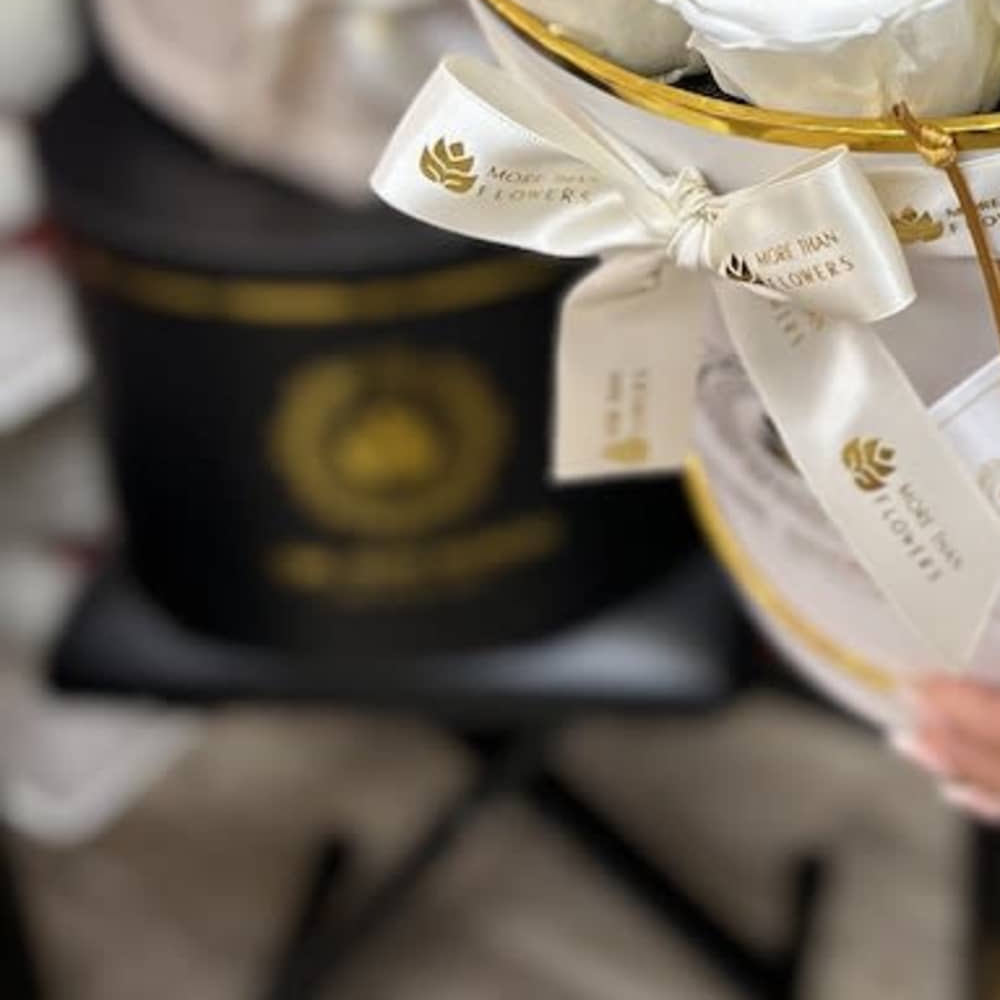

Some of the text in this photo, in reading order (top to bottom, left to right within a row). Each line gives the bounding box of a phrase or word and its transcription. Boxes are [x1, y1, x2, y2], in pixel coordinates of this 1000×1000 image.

[946, 198, 997, 218] MRE
[754, 229, 839, 263] MORE THAN
[900, 482, 935, 528] MORE
[874, 493, 945, 582] FLOWERS
